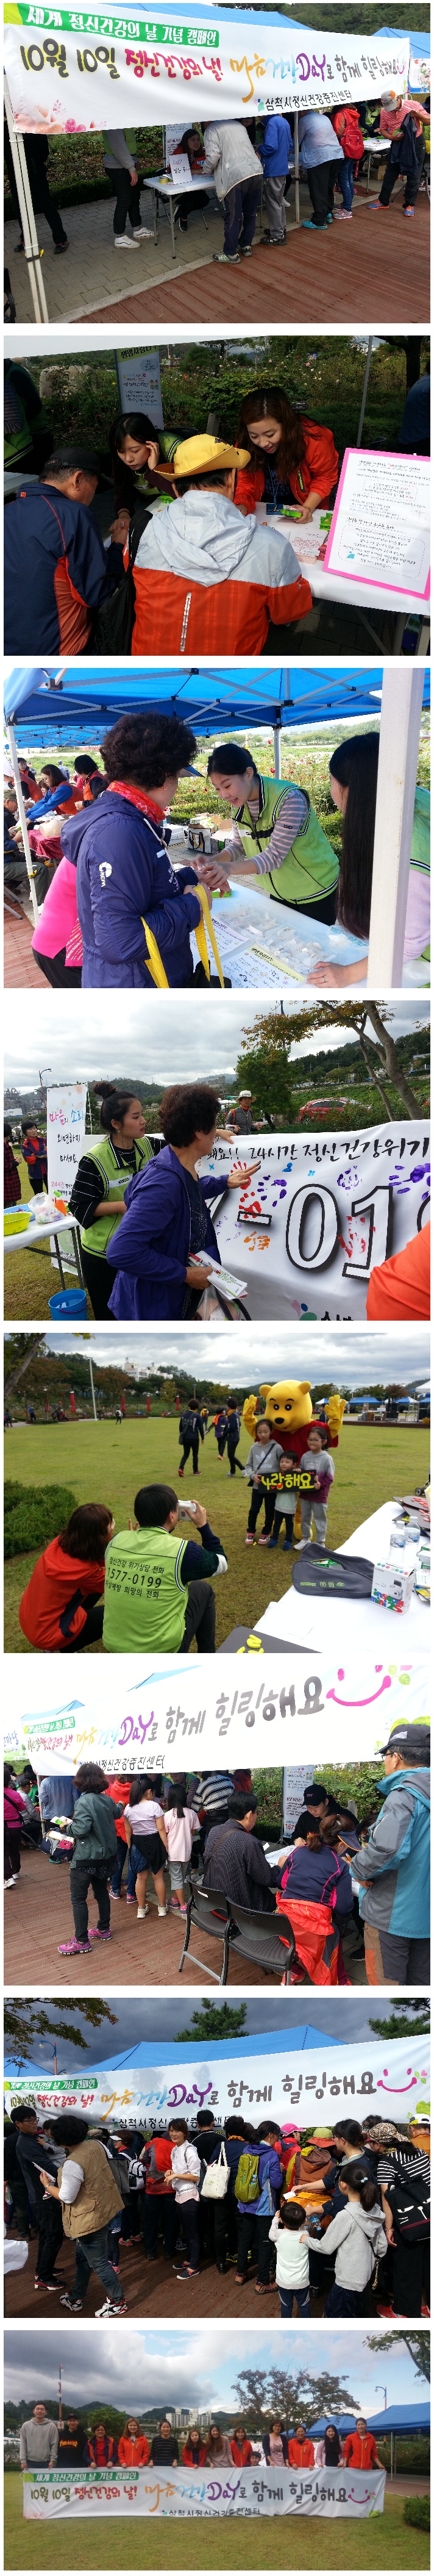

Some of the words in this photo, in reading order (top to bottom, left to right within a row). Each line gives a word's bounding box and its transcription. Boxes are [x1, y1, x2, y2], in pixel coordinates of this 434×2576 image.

[26, 6, 63, 27] 세계
[68, 13, 140, 38] 정신건강의
[145, 24, 158, 40] 날
[162, 26, 183, 43] 기념
[187, 29, 217, 46] 캠페인
[20, 38, 69, 78] 10월
[76, 46, 121, 79] 10일
[124, 48, 204, 81] 정신건강의
[202, 57, 224, 82] 날!
[335, 54, 362, 82] 함께
[361, 55, 398, 80] 힐링해요
[265, 90, 352, 112] 삼척시정신건강증진센터
[49, 1109, 68, 1125] 마음의
[71, 1109, 84, 1123] 소리
[57, 1133, 80, 1144] 외면하지
[247, 1144, 298, 1160] 24시간
[110, 1557, 127, 1568] 정신건강
[129, 1562, 151, 1572] 위기상담
[152, 1566, 165, 1575] 전화
[108, 1567, 162, 1588] 1577-0199
[124, 1586, 142, 1597] 희망의
[146, 1590, 159, 1599] 전화
[371, 1596, 386, 1607] mini
[165, 1706, 207, 1743] 함께
[216, 1676, 325, 1737] 힐링해요
[54, 2081, 60, 2090] 날
[76, 2079, 96, 2089] 캠페인
[80, 2094, 94, 2108] 날!
[227, 2080, 272, 2108] 함께
[282, 2071, 377, 2104] 힐링해요
[52, 2473, 87, 2482] 정신건강의
[115, 2472, 137, 2480] 캠페인
[31, 2486, 49, 2503] 10월
[52, 2487, 71, 2502] 10일
[74, 2486, 120, 2500] 정신건강의
[124, 2485, 138, 2500] 날!
[252, 2480, 283, 2502] 함께
[289, 2481, 348, 2505] 힐링해요
